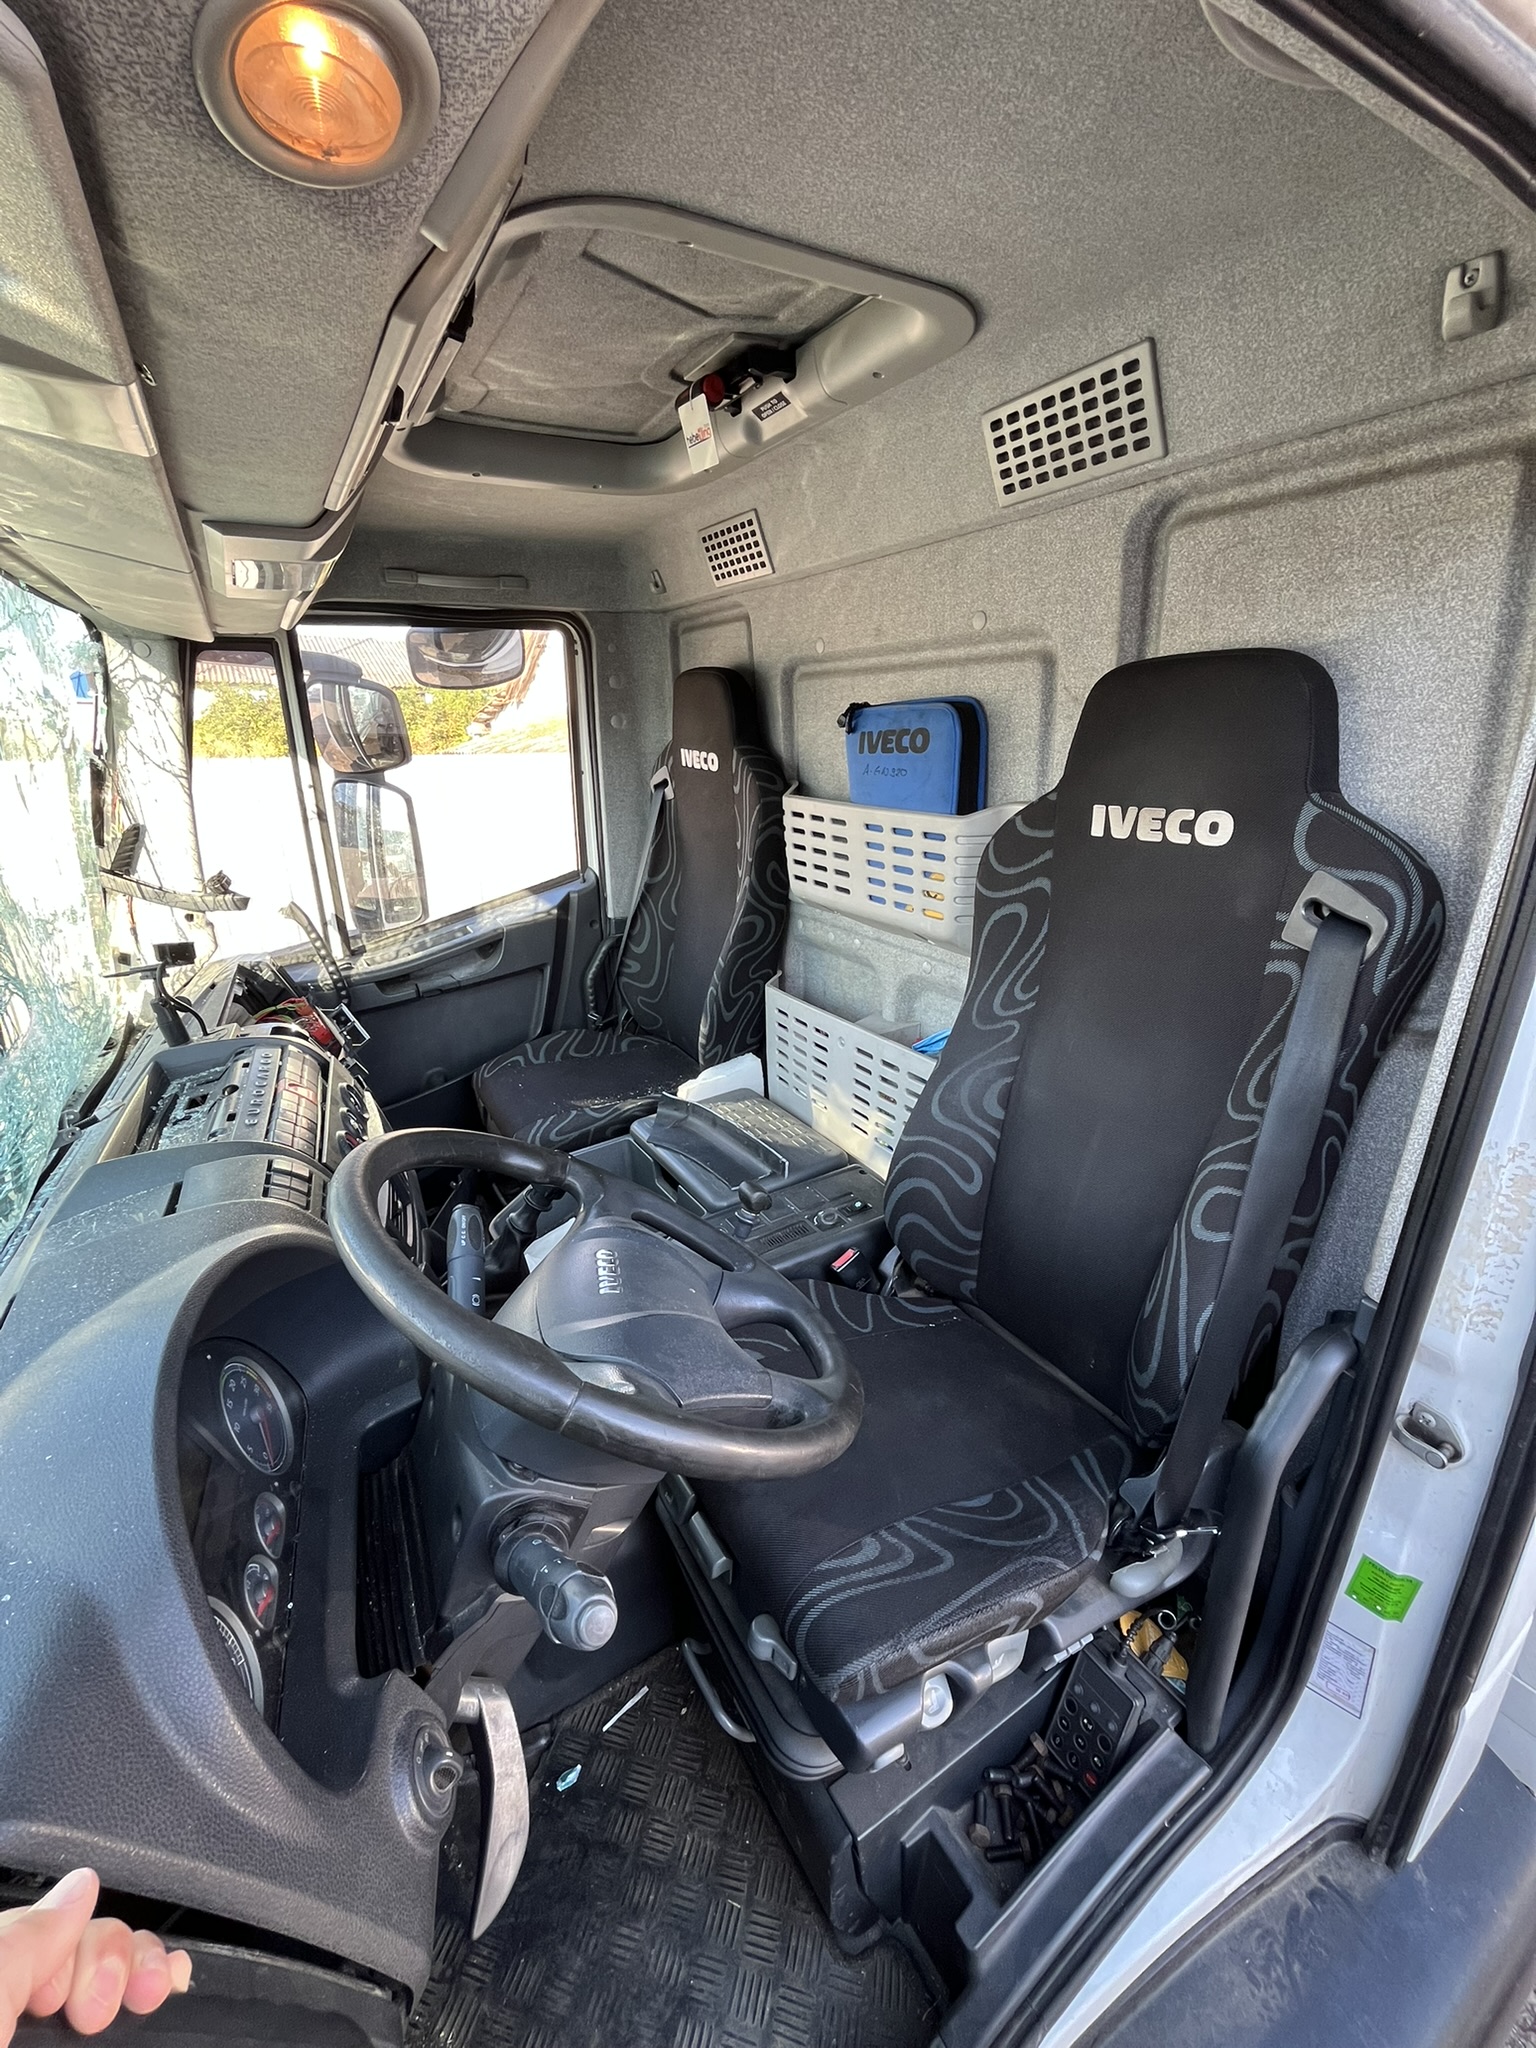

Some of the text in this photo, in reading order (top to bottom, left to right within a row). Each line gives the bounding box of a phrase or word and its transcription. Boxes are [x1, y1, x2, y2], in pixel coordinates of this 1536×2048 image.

[858, 727, 931, 755] IVECO
[680, 748, 719, 772] IVECO
[1090, 804, 1235, 847] IVECO
[244, 1051, 273, 1126] EUROCARGO
[595, 1249, 624, 1295] IVECO
[228, 1378, 237, 1392] 20
[226, 1398, 234, 1409] 15
[233, 1422, 241, 1433] 10
[246, 1444, 254, 1453] 5
[262, 1451, 269, 1460] 0
